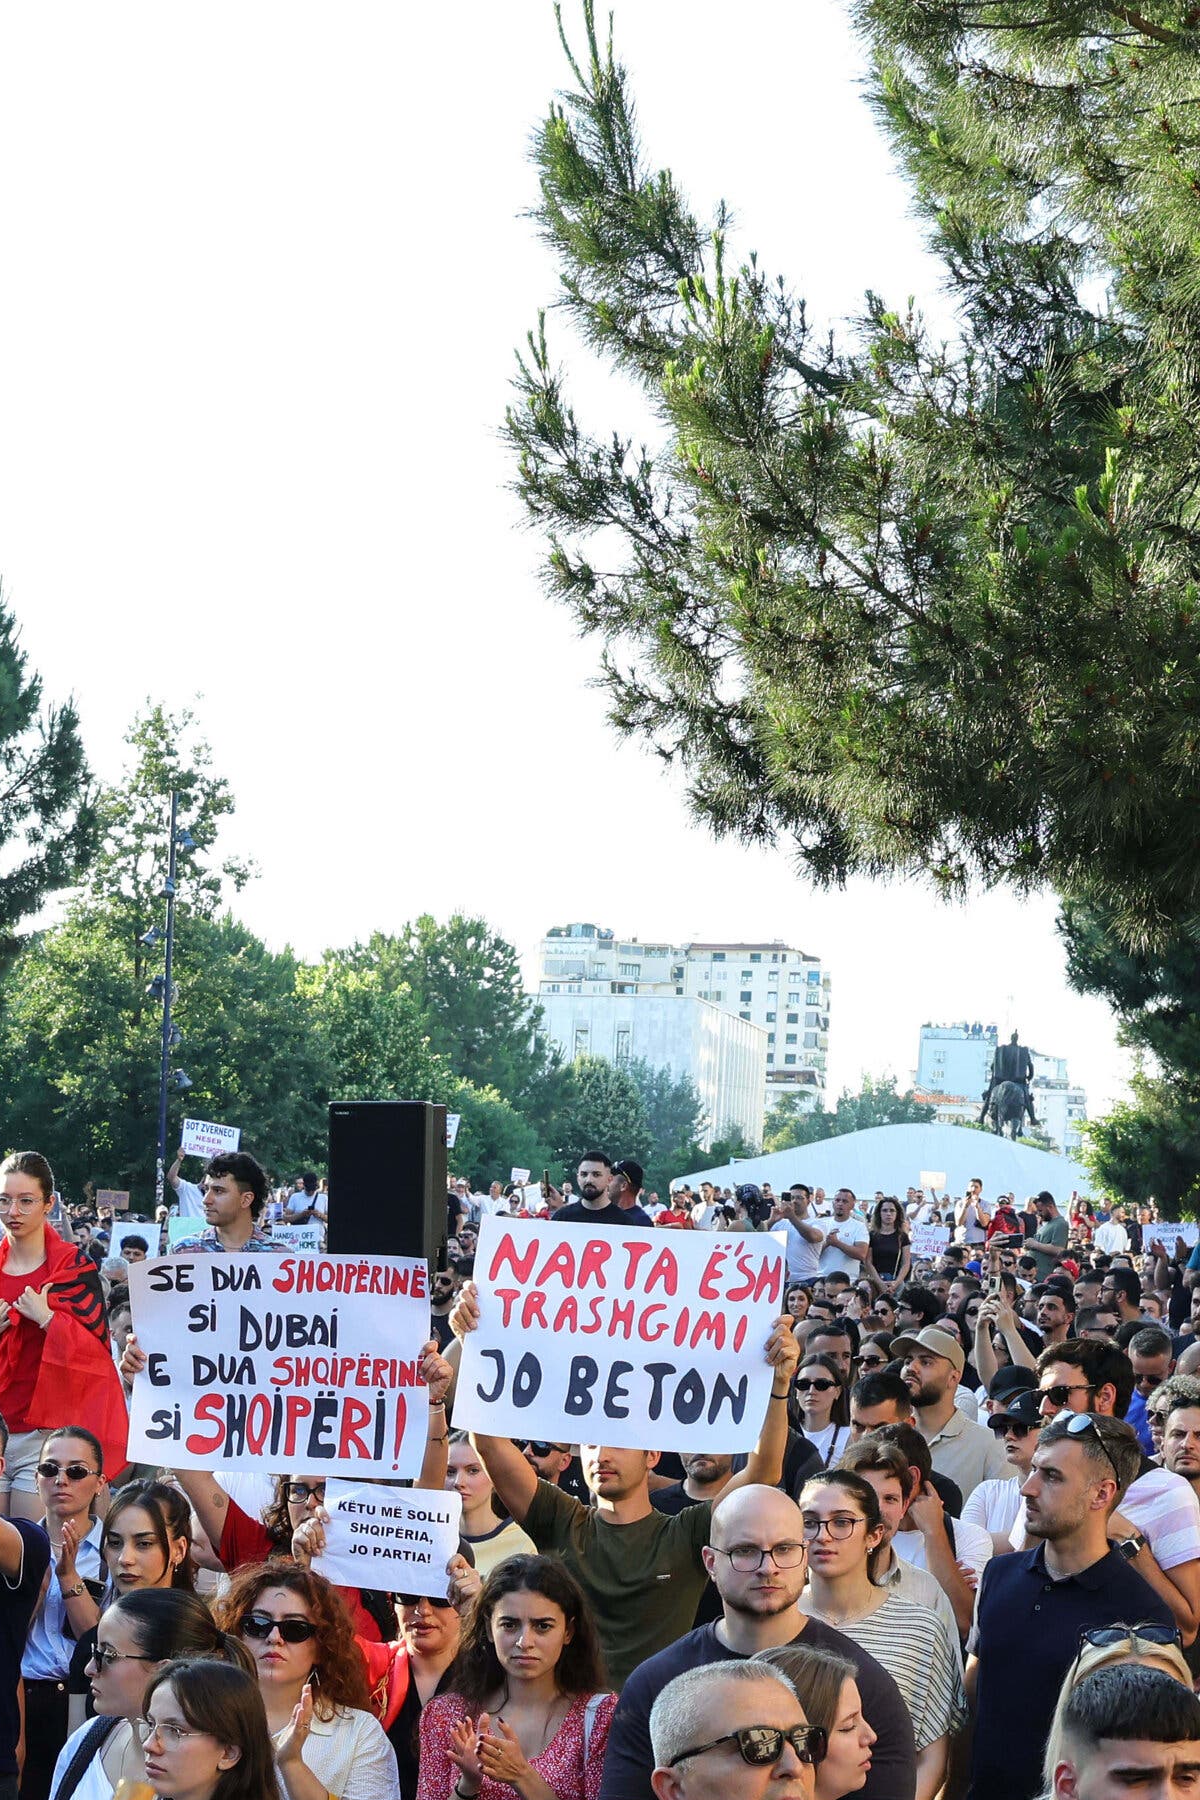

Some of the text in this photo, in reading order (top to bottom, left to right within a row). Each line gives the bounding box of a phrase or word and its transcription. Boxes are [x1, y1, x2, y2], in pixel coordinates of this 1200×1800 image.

[185, 1121, 235, 1138] SOT ZVERNECI
[299, 1241, 316, 1250] HOME
[147, 1258, 427, 1298] SE DUA SHQIPËRINË
[488, 1232, 678, 1297] NARTA
[494, 1288, 748, 1353] TRASHGIMI
[148, 1353, 171, 1387] E
[192, 1353, 256, 1386] DUA
[476, 1349, 748, 1425] JO BETON
[337, 1500, 450, 1524] KËTU MË SOLLI
[350, 1522, 433, 1545] SHQIPËRIA,
[349, 1544, 431, 1564] JO PARTIA!
